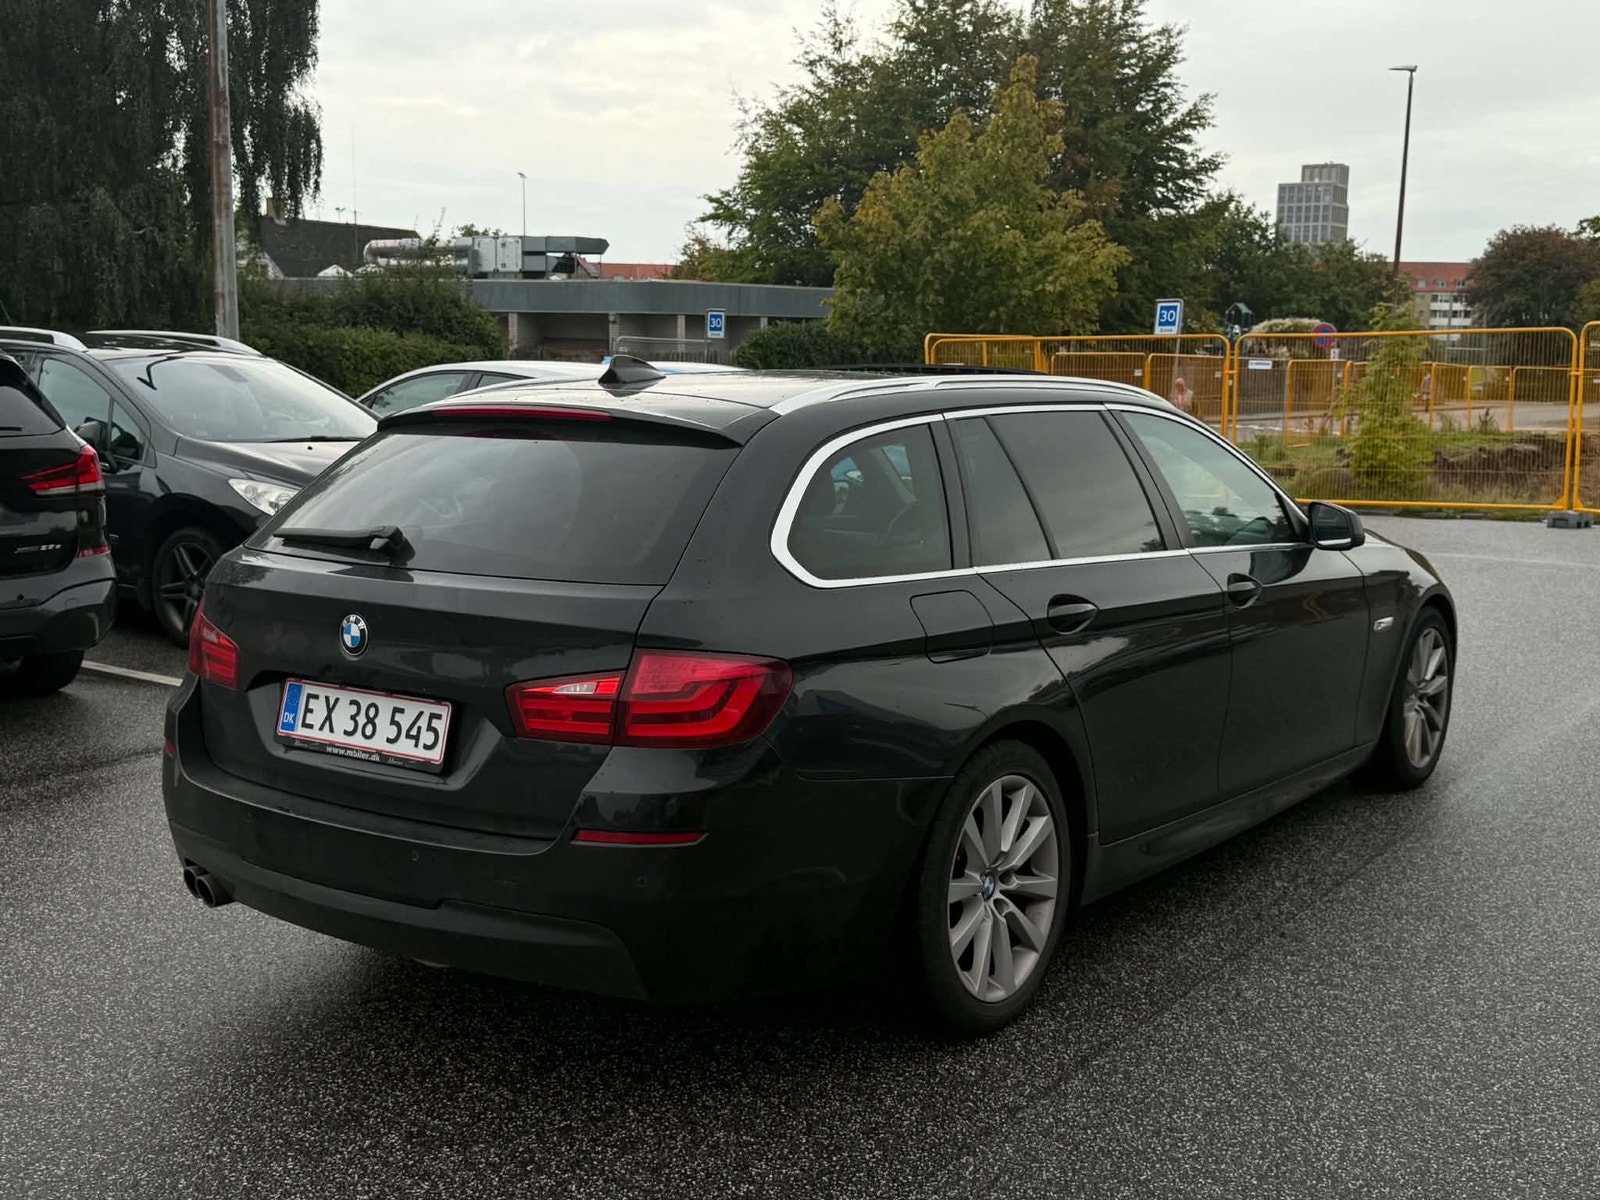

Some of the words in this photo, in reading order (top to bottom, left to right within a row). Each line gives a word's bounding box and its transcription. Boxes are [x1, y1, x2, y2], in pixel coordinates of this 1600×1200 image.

[1160, 310, 1176, 322] 30
[710, 317, 722, 328] 30
[283, 711, 295, 724] DK
[301, 692, 340, 734] EX
[343, 699, 380, 740] 38
[386, 706, 443, 751] 545
